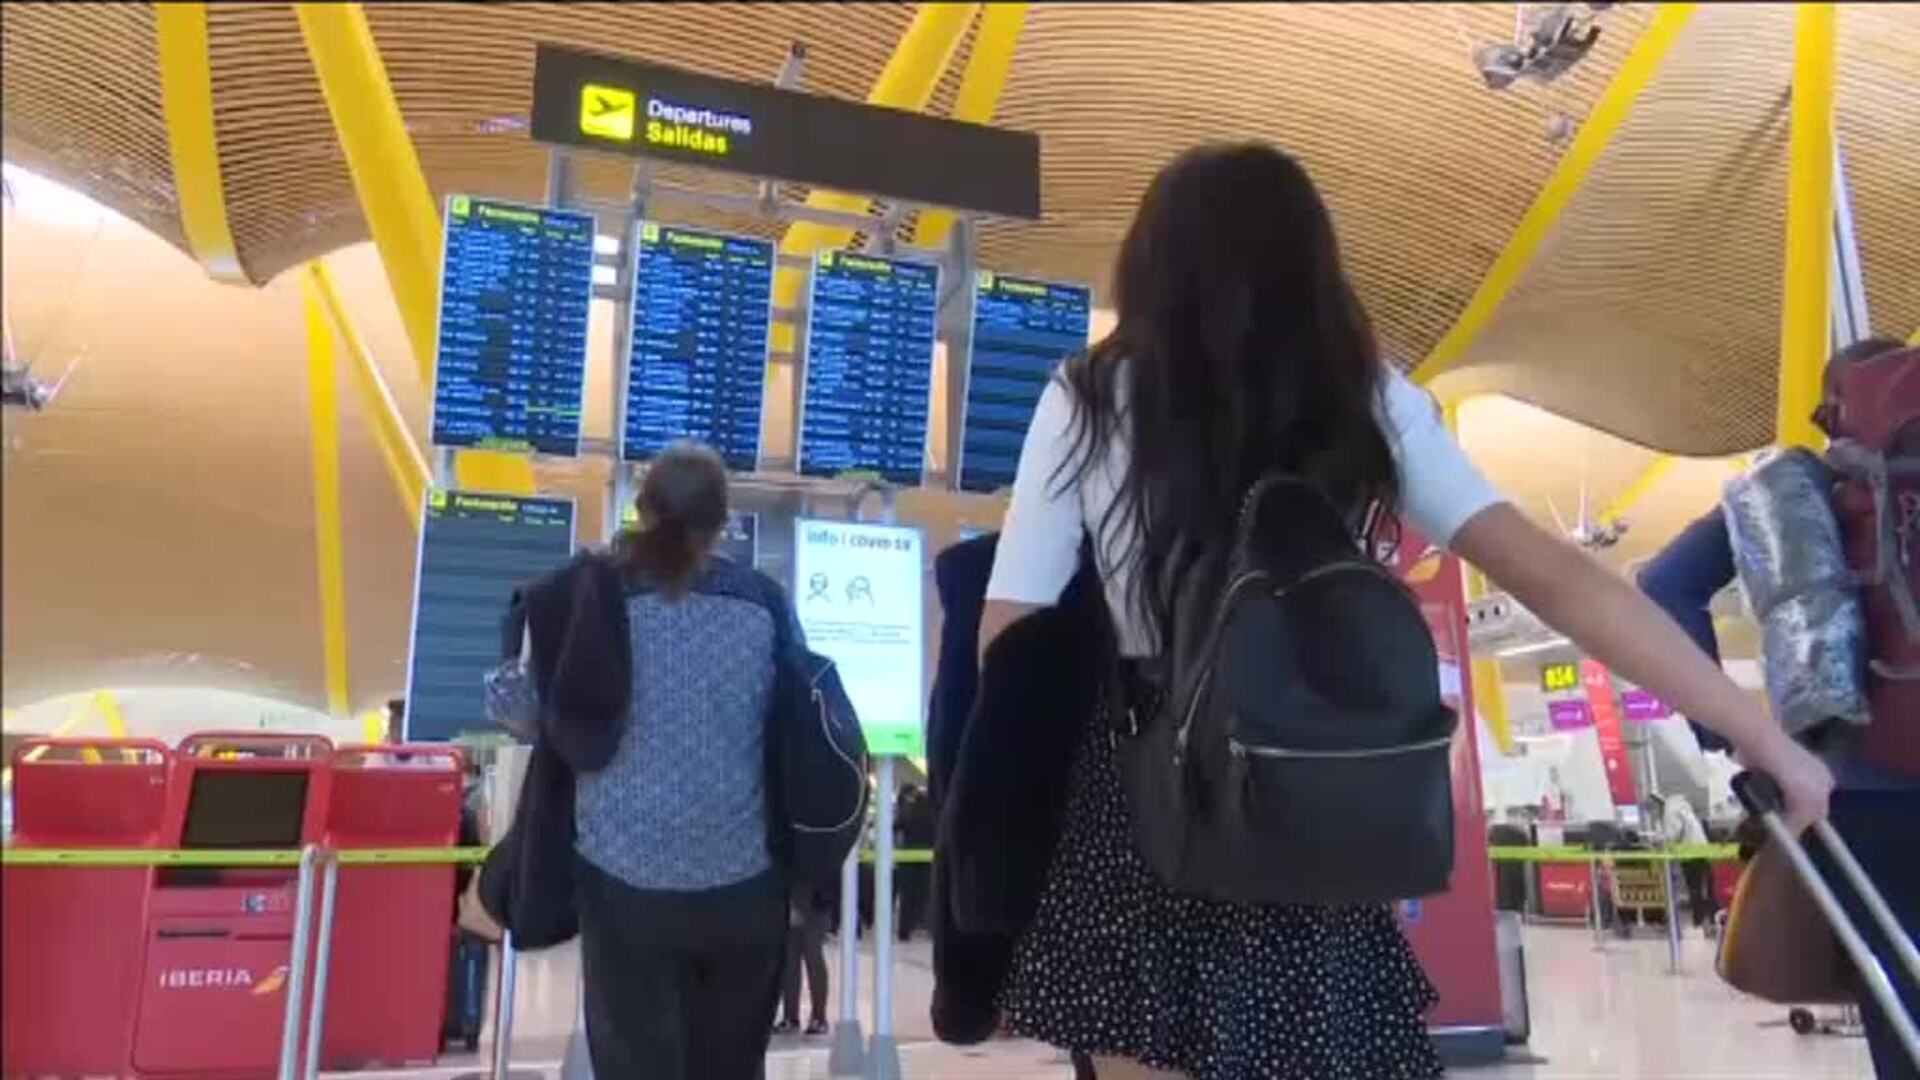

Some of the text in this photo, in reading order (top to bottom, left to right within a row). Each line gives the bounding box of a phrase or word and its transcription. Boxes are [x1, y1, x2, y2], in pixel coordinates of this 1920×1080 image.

[647, 98, 752, 136] Departures
[645, 120, 728, 154] Salidas
[159, 967, 252, 989] IBERIA
